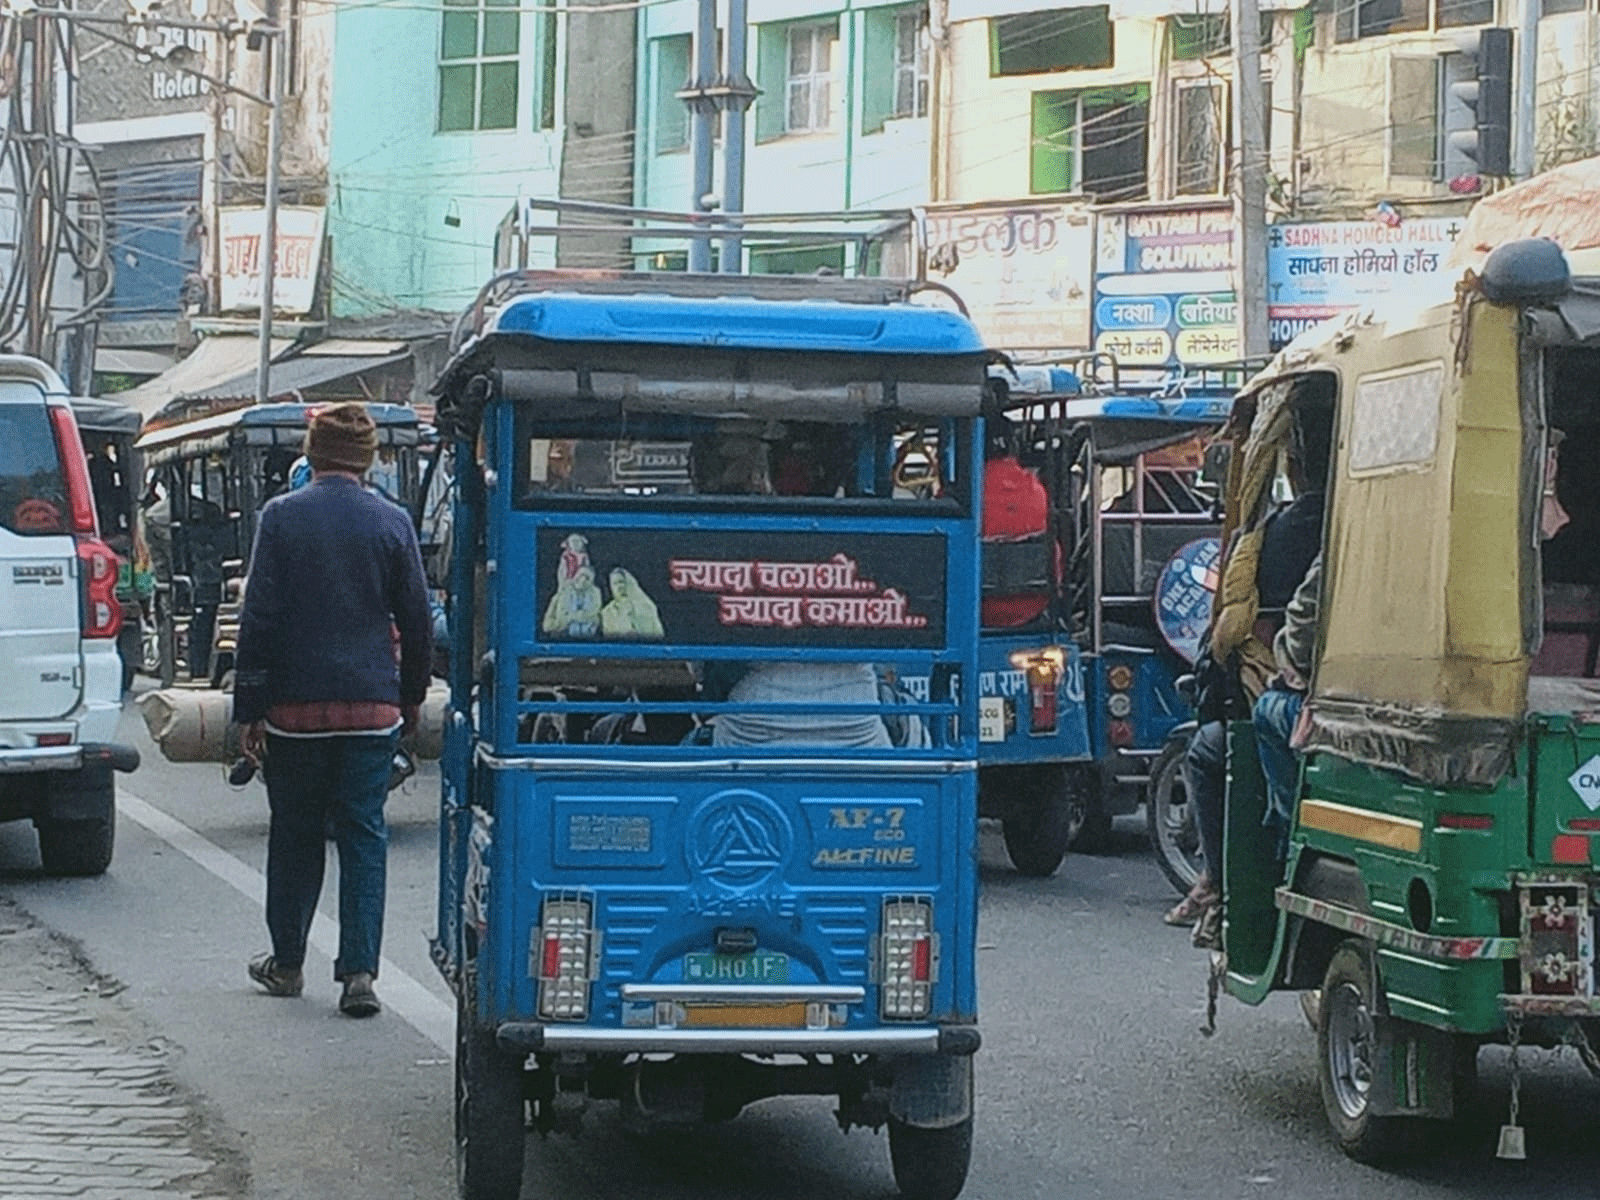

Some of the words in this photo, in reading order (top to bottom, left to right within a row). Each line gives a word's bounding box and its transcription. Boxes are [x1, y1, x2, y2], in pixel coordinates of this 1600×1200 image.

[1285, 228, 1338, 246] SADHNA
[1408, 224, 1443, 243] HALL
[1288, 256, 1339, 276] साधना
[1343, 248, 1398, 276] होमियो
[1403, 248, 1440, 274] हॉल
[1112, 303, 1156, 324] नक्शा
[670, 560, 753, 591] ज्यादा
[719, 595, 801, 626] ज्यादा
[1579, 773, 1600, 790] CN
[704, 956, 775, 979] JH01F
